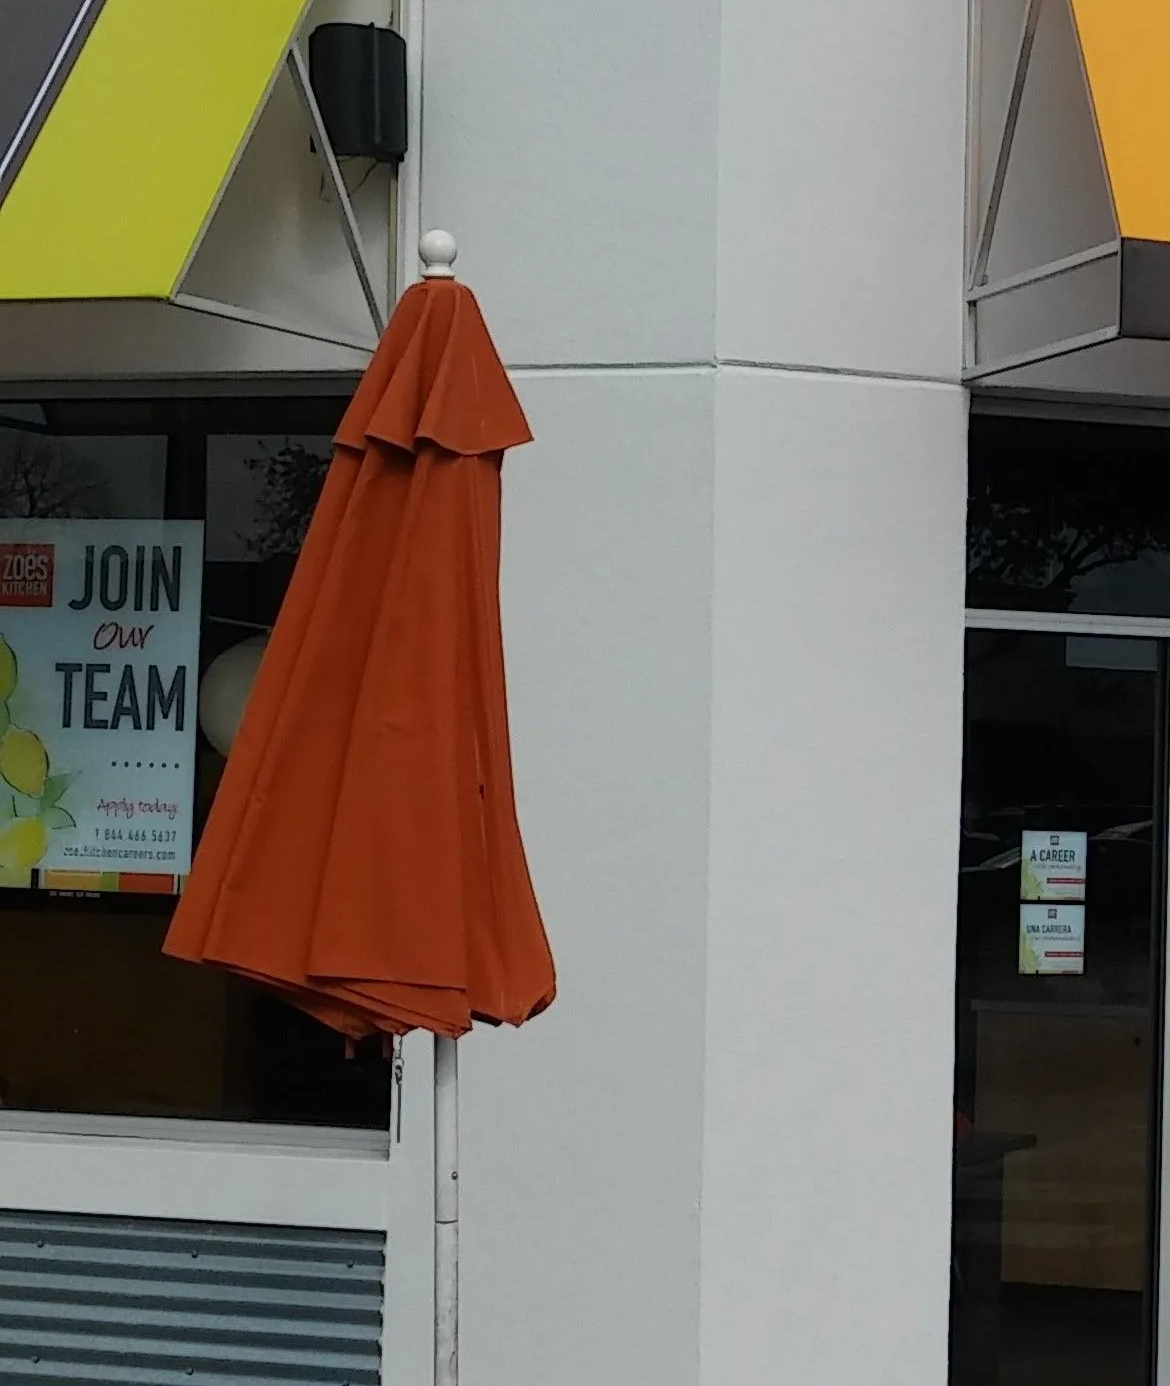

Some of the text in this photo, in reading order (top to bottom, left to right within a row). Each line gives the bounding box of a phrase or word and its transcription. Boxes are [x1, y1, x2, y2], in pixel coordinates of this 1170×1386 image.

[1, 580, 48, 596] KITCHEN
[69, 544, 182, 612] JOIN
[93, 621, 154, 650] Our
[55, 663, 187, 732] TEAM
[97, 798, 134, 819] Apply
[104, 828, 123, 841] 844
[1030, 849, 1075, 863] A CAREER
